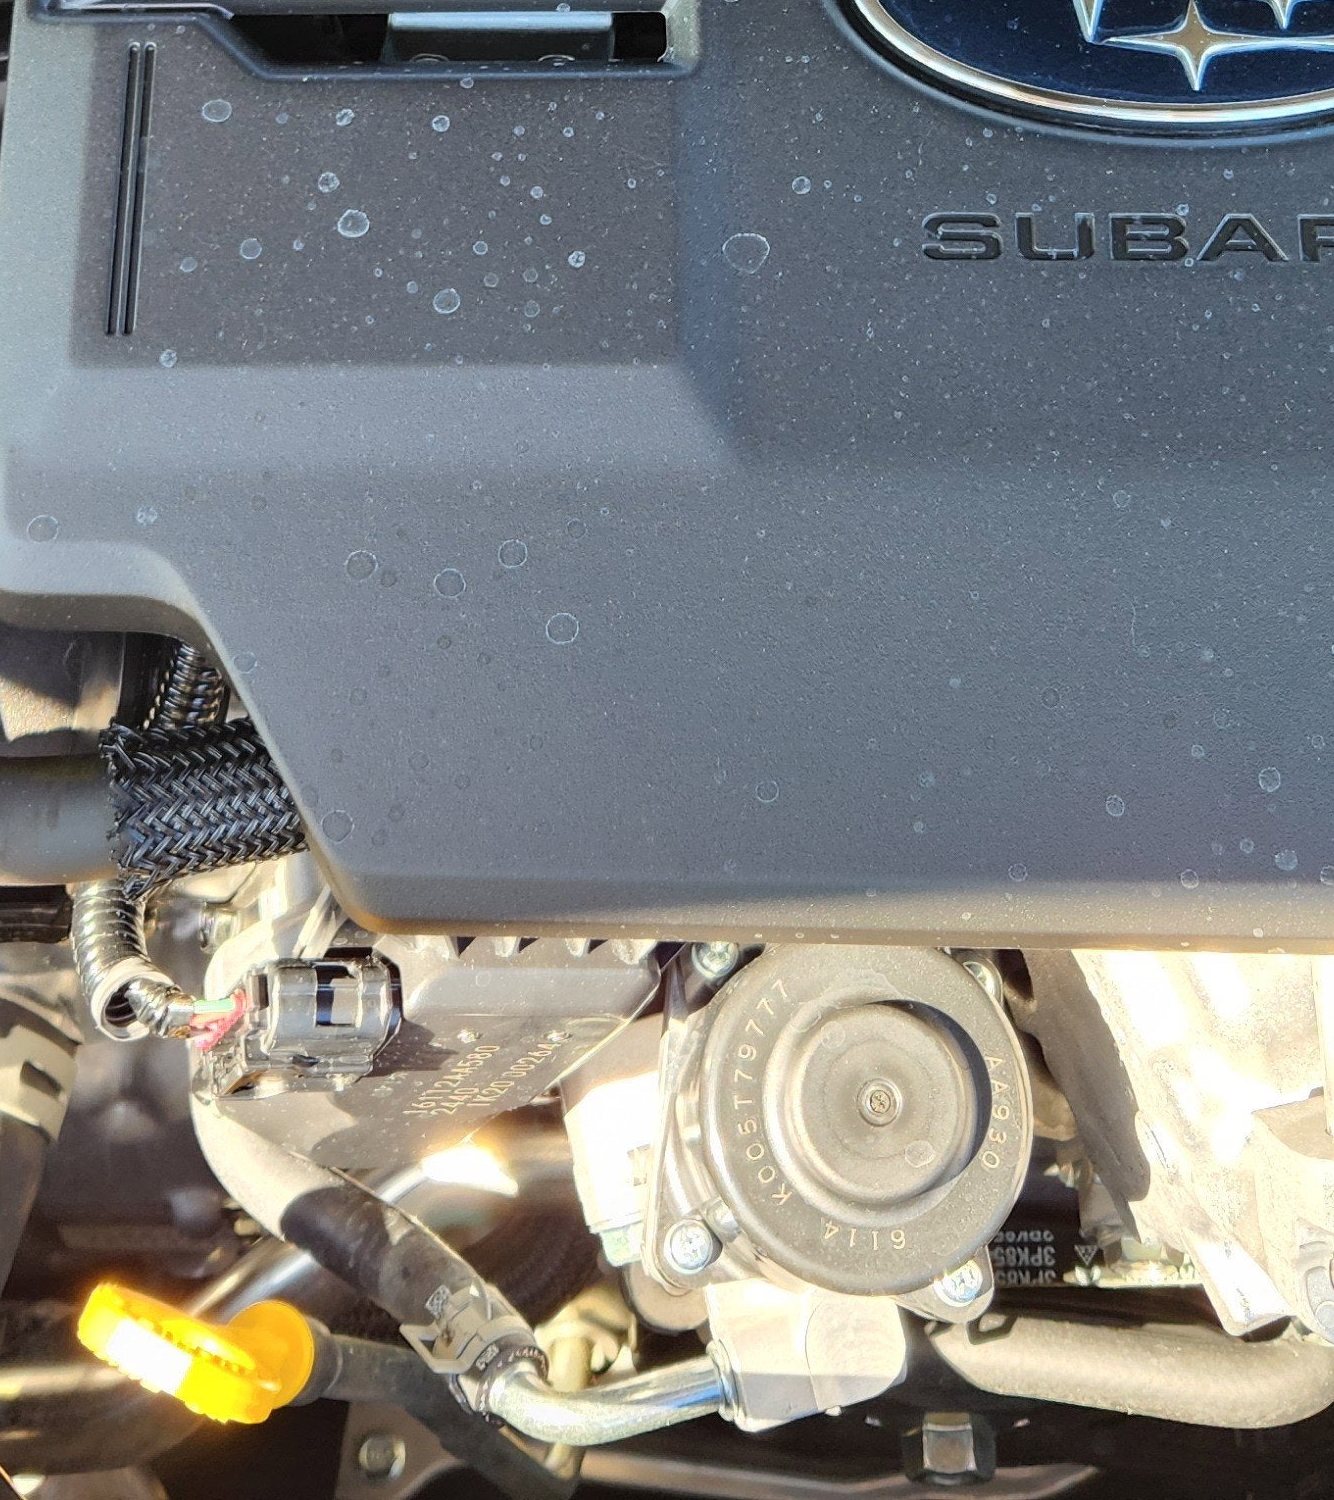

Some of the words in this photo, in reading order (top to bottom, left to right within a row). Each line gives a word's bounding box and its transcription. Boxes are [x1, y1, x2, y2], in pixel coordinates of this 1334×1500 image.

[402, 1045, 500, 1115] 16112AA580
[430, 1087, 480, 1116] 2440
[733, 978, 793, 1206] K005T79777
[981, 1054, 1011, 1170] AA930
[823, 1218, 906, 1251] 6114
